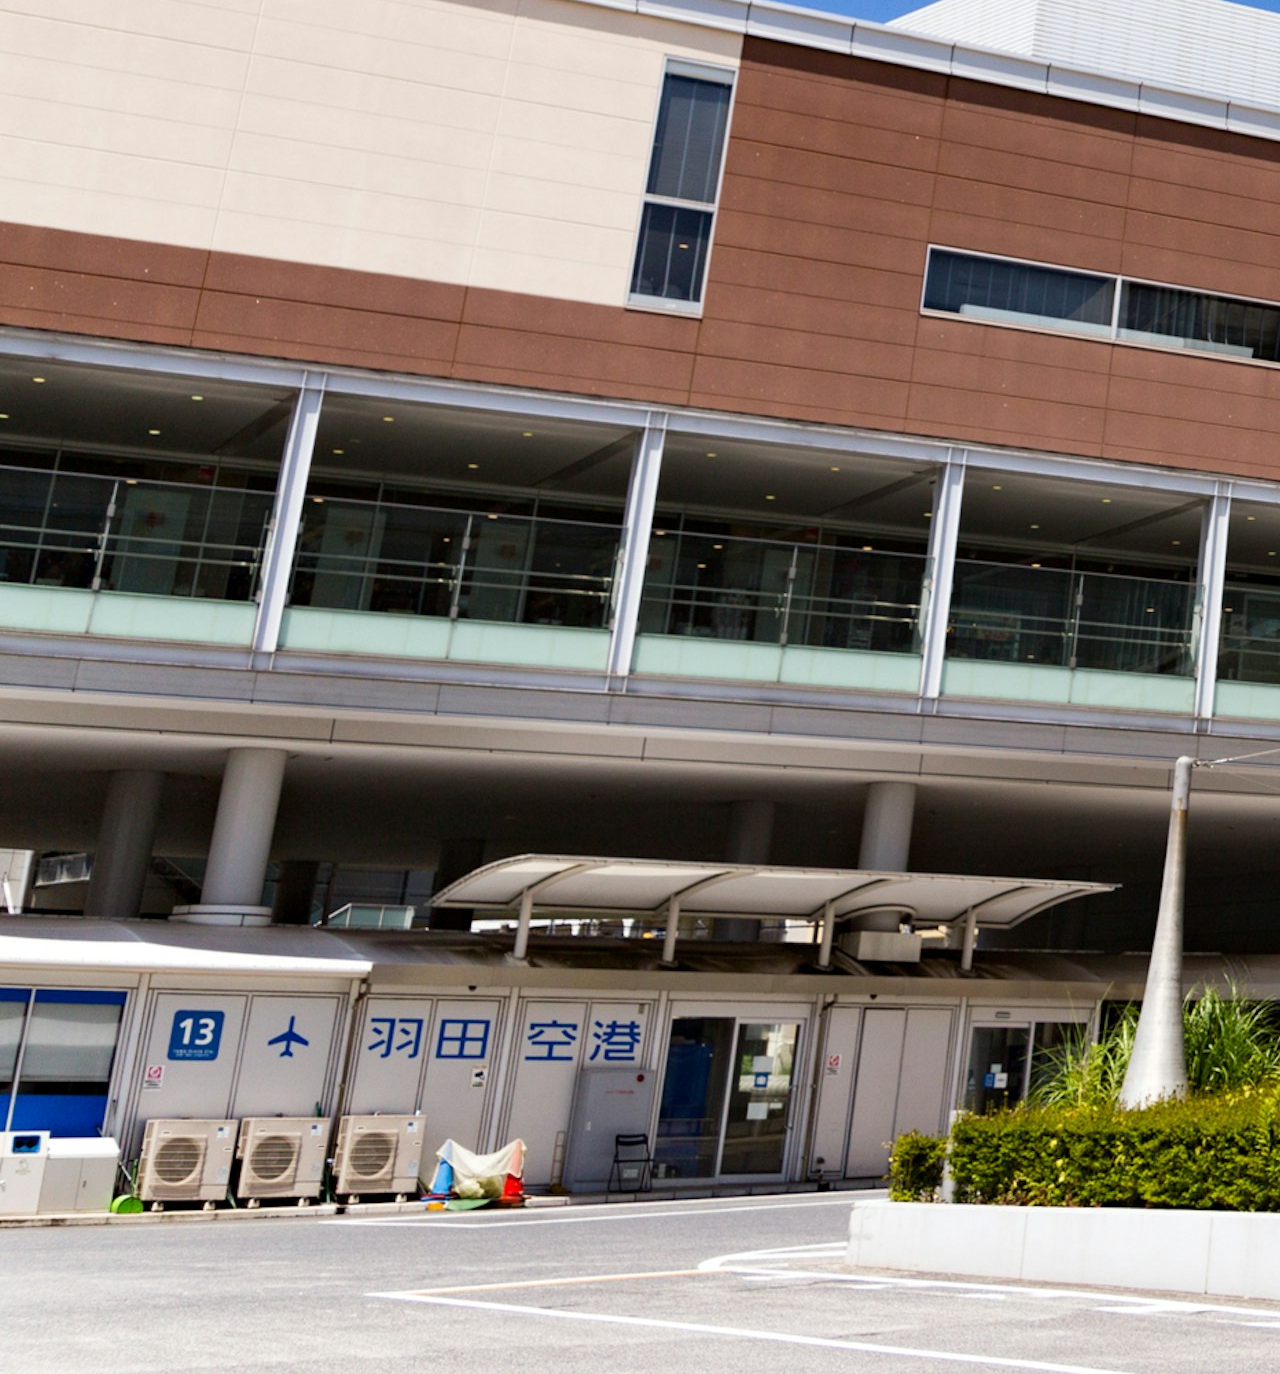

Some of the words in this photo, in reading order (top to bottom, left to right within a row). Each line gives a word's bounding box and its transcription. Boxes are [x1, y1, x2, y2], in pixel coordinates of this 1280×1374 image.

[179, 1017, 216, 1046] 13
[368, 1018, 641, 1062] 羽田空港
